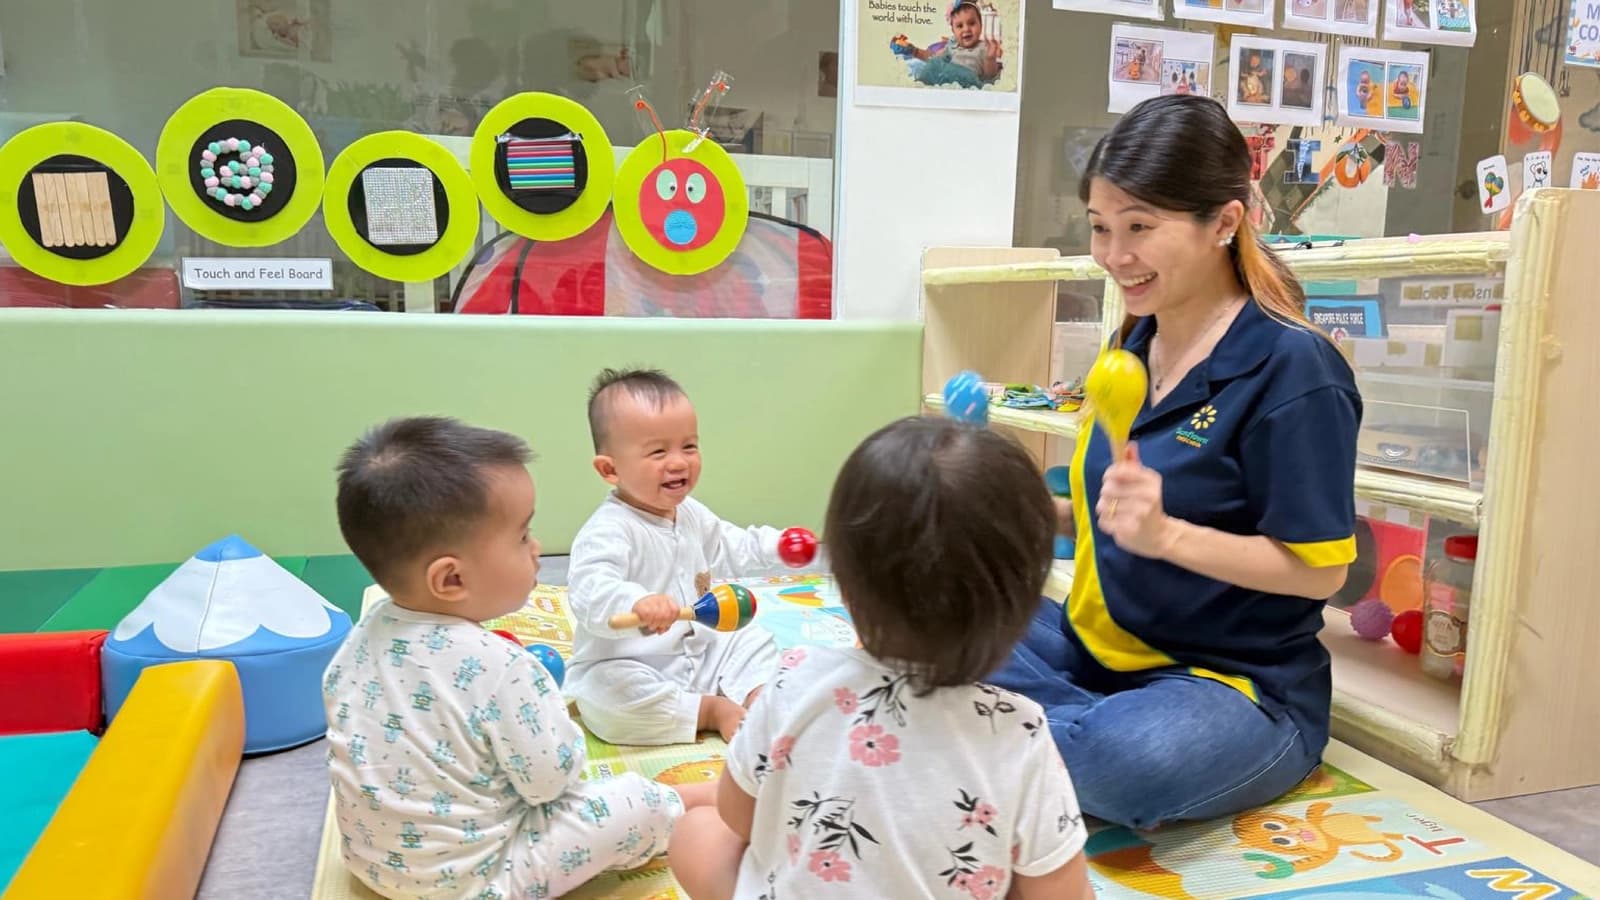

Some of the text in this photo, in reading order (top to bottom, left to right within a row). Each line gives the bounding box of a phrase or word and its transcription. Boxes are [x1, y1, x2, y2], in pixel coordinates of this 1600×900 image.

[868, 1, 937, 14] Babies touch the
[872, 12, 934, 25] world with love.
[1579, 24, 1600, 41] CO
[194, 268, 323, 280] Touch and Feel Board
[1405, 835, 1467, 856] T
